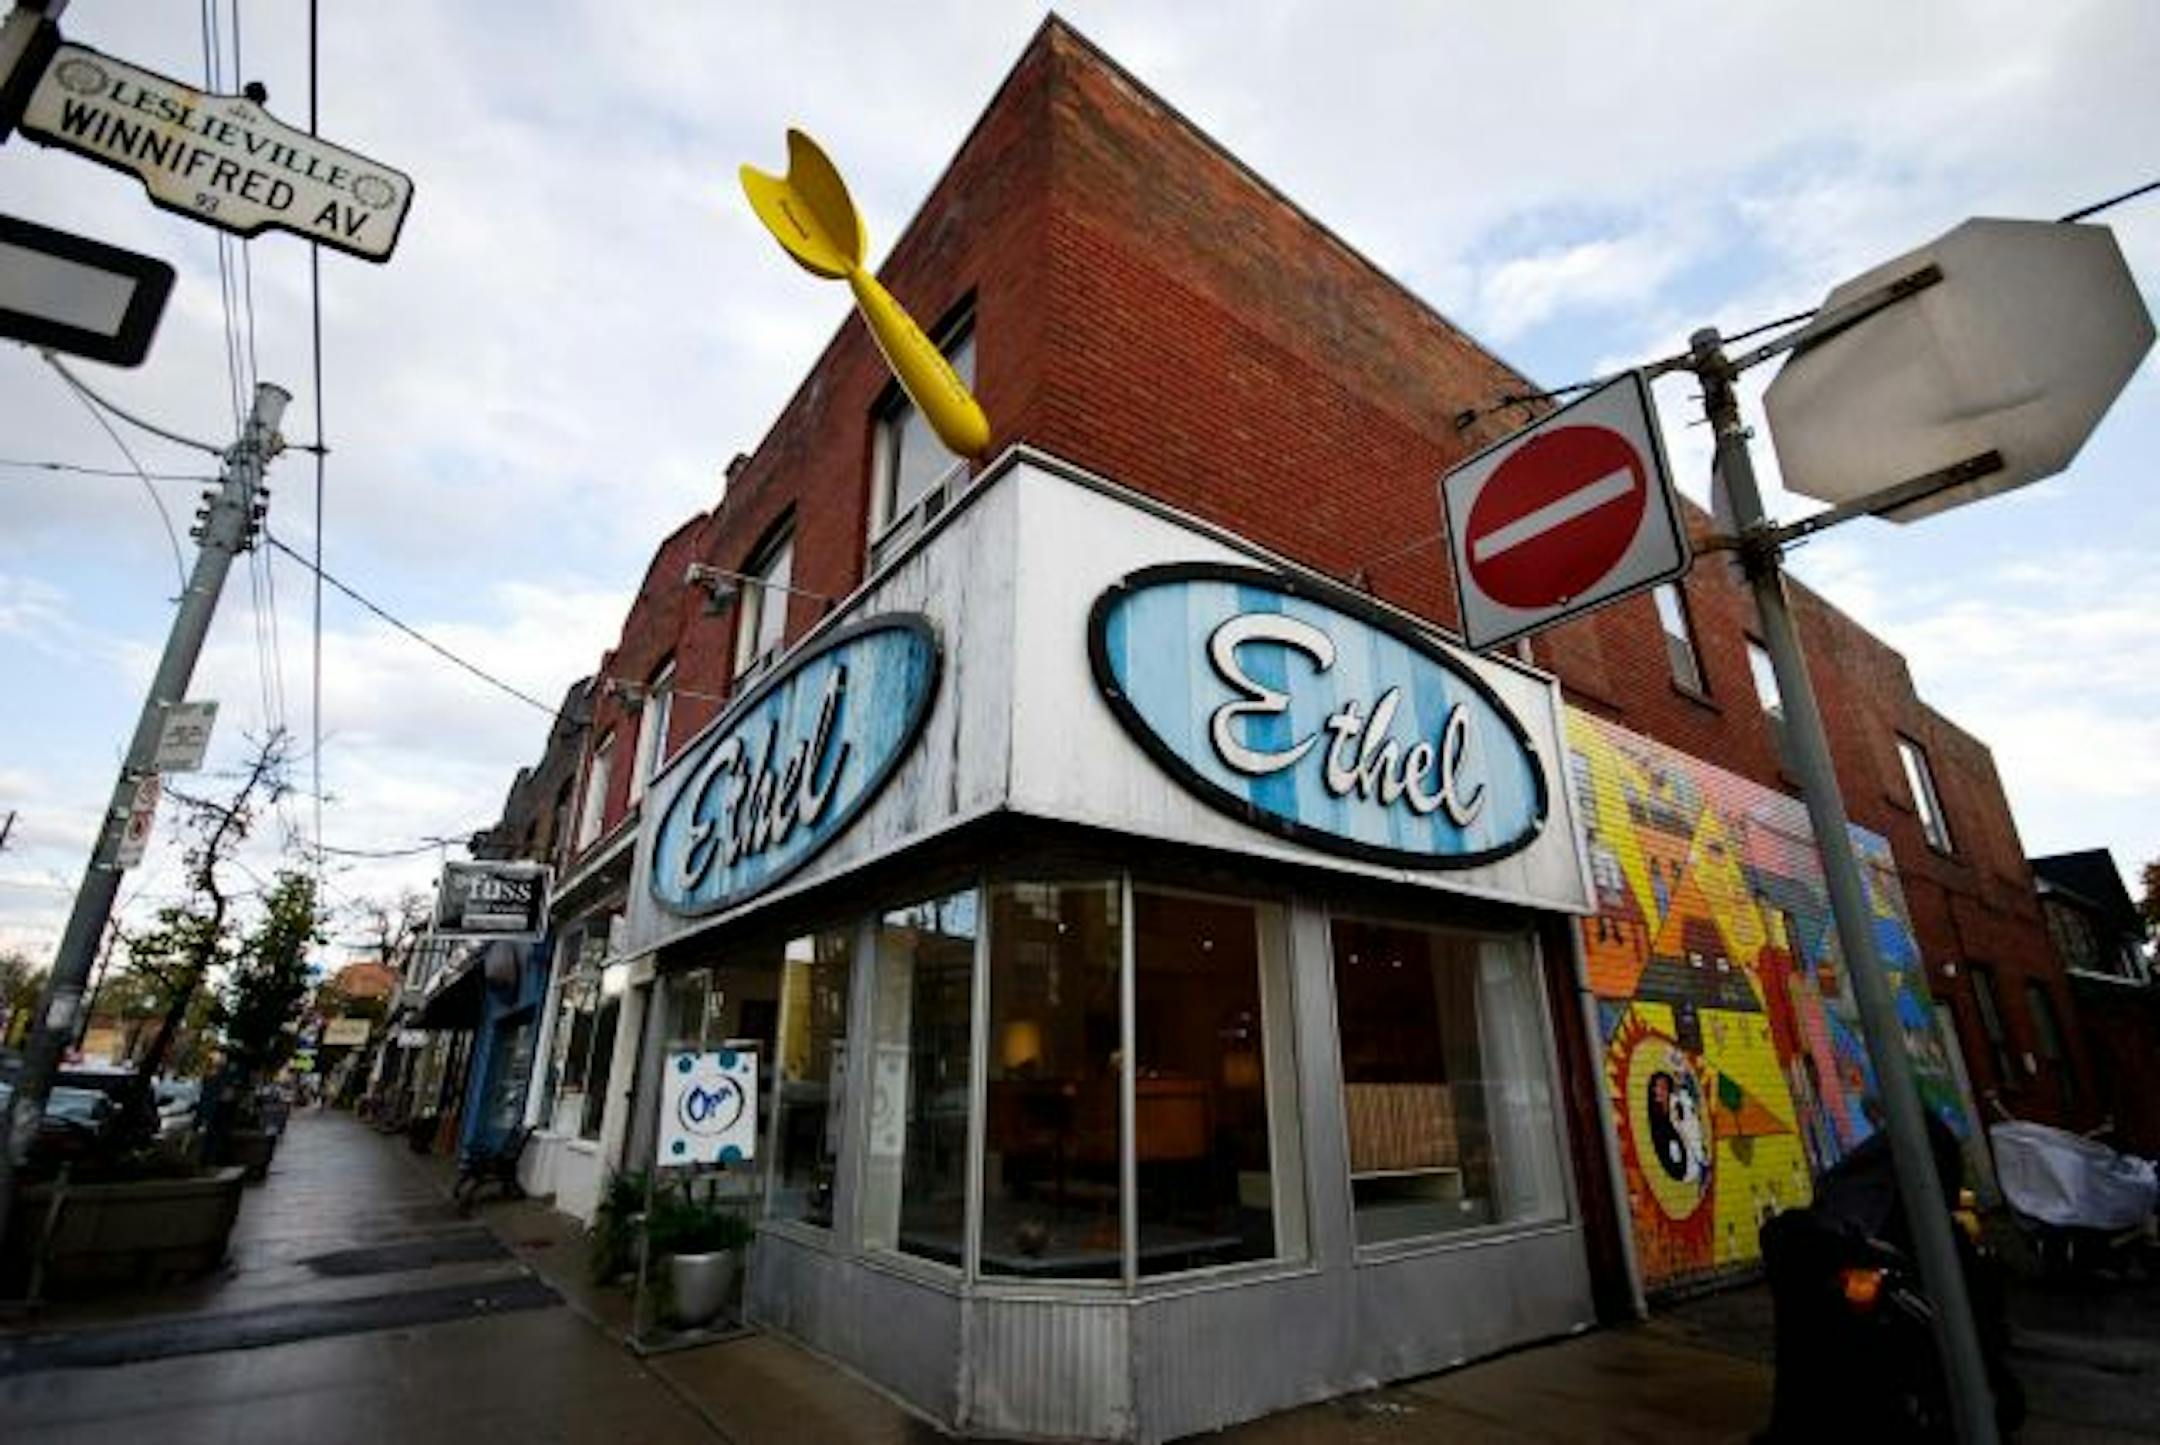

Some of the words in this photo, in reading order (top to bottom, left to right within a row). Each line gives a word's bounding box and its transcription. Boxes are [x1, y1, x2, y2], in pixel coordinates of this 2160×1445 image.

[61, 98, 295, 210] WINNIFRED
[109, 81, 350, 190] LESLIEVILLE
[677, 664, 851, 891] Ethel
[1205, 612, 1486, 829] Ethel
